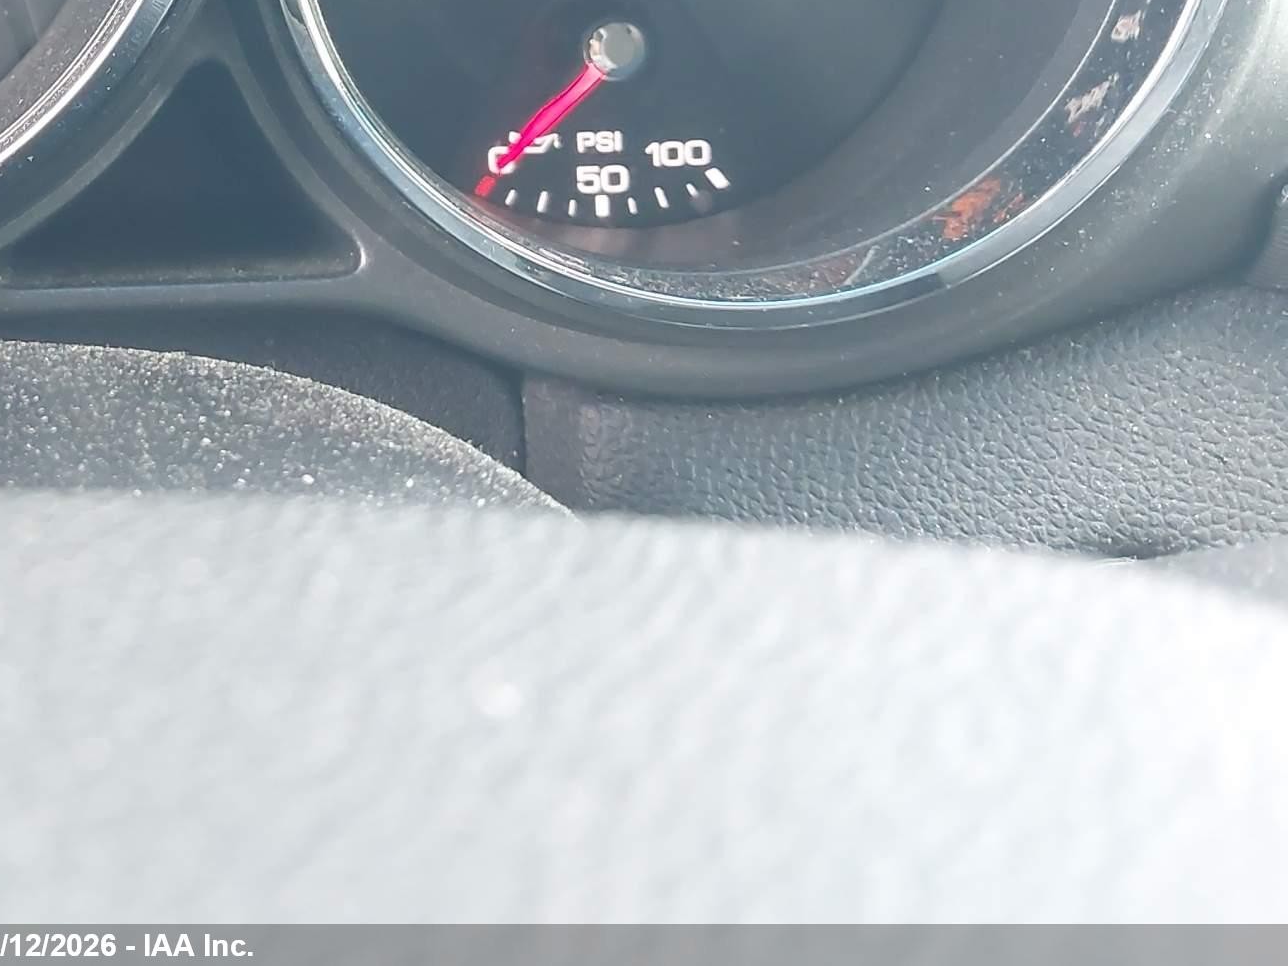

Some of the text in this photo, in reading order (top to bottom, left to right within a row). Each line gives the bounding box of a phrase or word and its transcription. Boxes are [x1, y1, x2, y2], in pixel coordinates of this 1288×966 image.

[576, 130, 624, 153] PSI
[645, 139, 712, 168] 100
[576, 164, 630, 194] 50
